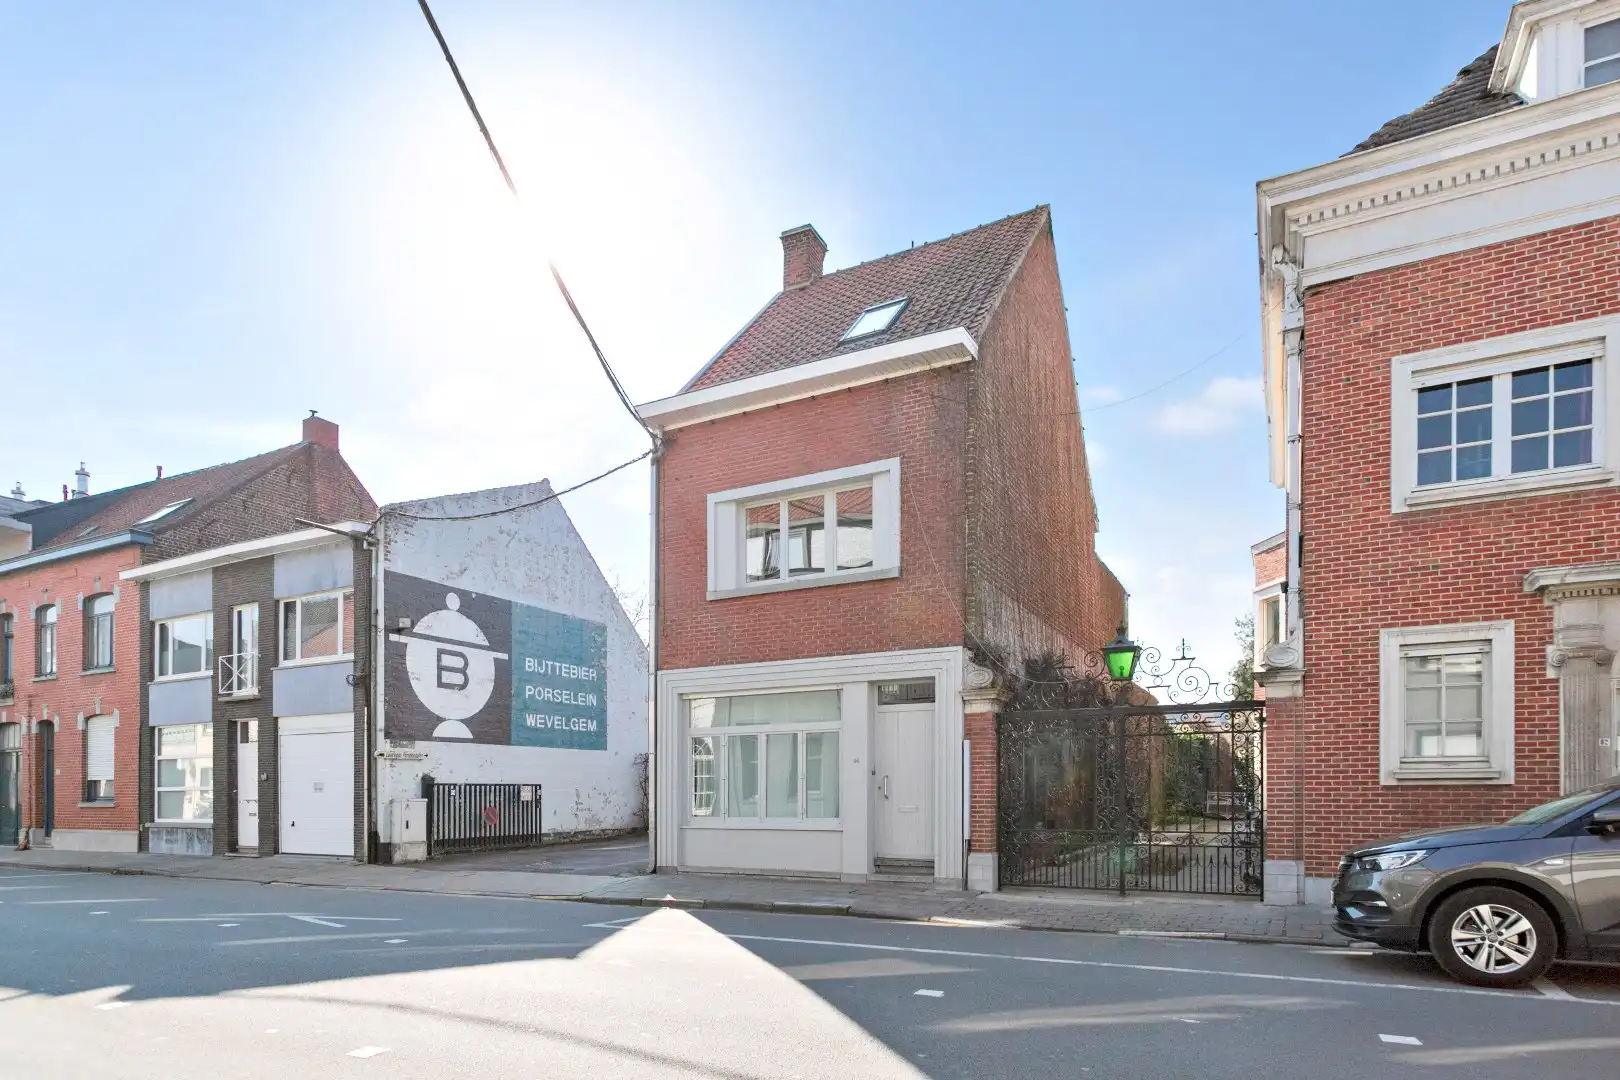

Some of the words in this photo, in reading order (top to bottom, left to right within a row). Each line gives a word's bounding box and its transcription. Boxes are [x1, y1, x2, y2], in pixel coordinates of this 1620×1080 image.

[437, 648, 470, 691] B
[525, 657, 598, 682] BIJTTEBIER
[525, 685, 597, 707] PORSELEIN
[525, 713, 597, 732] WEVELGEM
